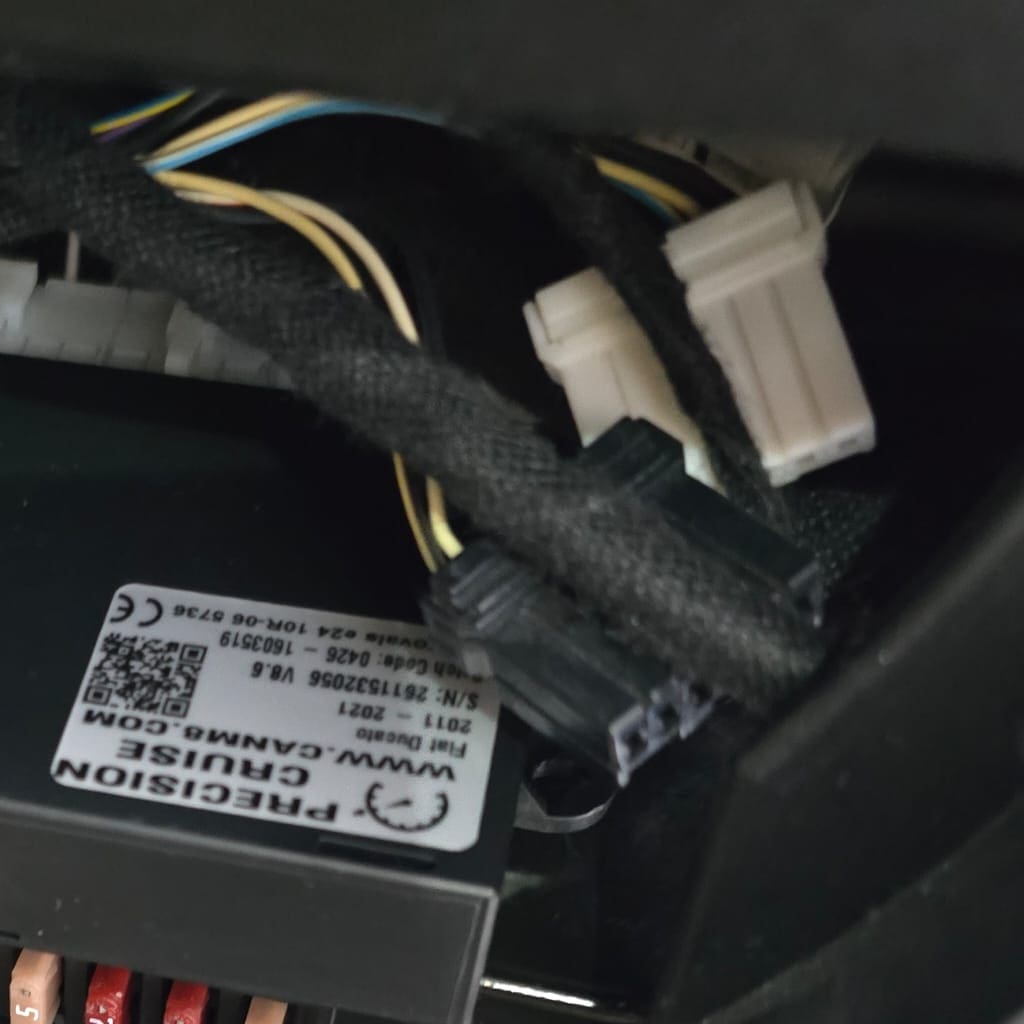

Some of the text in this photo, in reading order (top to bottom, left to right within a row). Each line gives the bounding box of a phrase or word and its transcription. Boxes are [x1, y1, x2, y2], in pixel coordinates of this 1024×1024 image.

[109, 593, 163, 627] CE
[172, 604, 225, 623] 5736
[231, 612, 307, 635] 10R-06
[317, 624, 357, 639] e24
[218, 630, 293, 656] 1603519
[325, 645, 371, 668] 0426
[377, 652, 428, 676] Code:
[250, 660, 480, 711] S/N: 2611532056 V8.6
[338, 700, 386, 722] 2021
[424, 713, 473, 735] 2011
[355, 726, 468, 759] Fiat Ducato
[115, 738, 310, 788] CRUISE
[55, 759, 338, 823] PRECISION
[15, 1004, 40, 1021] 5
